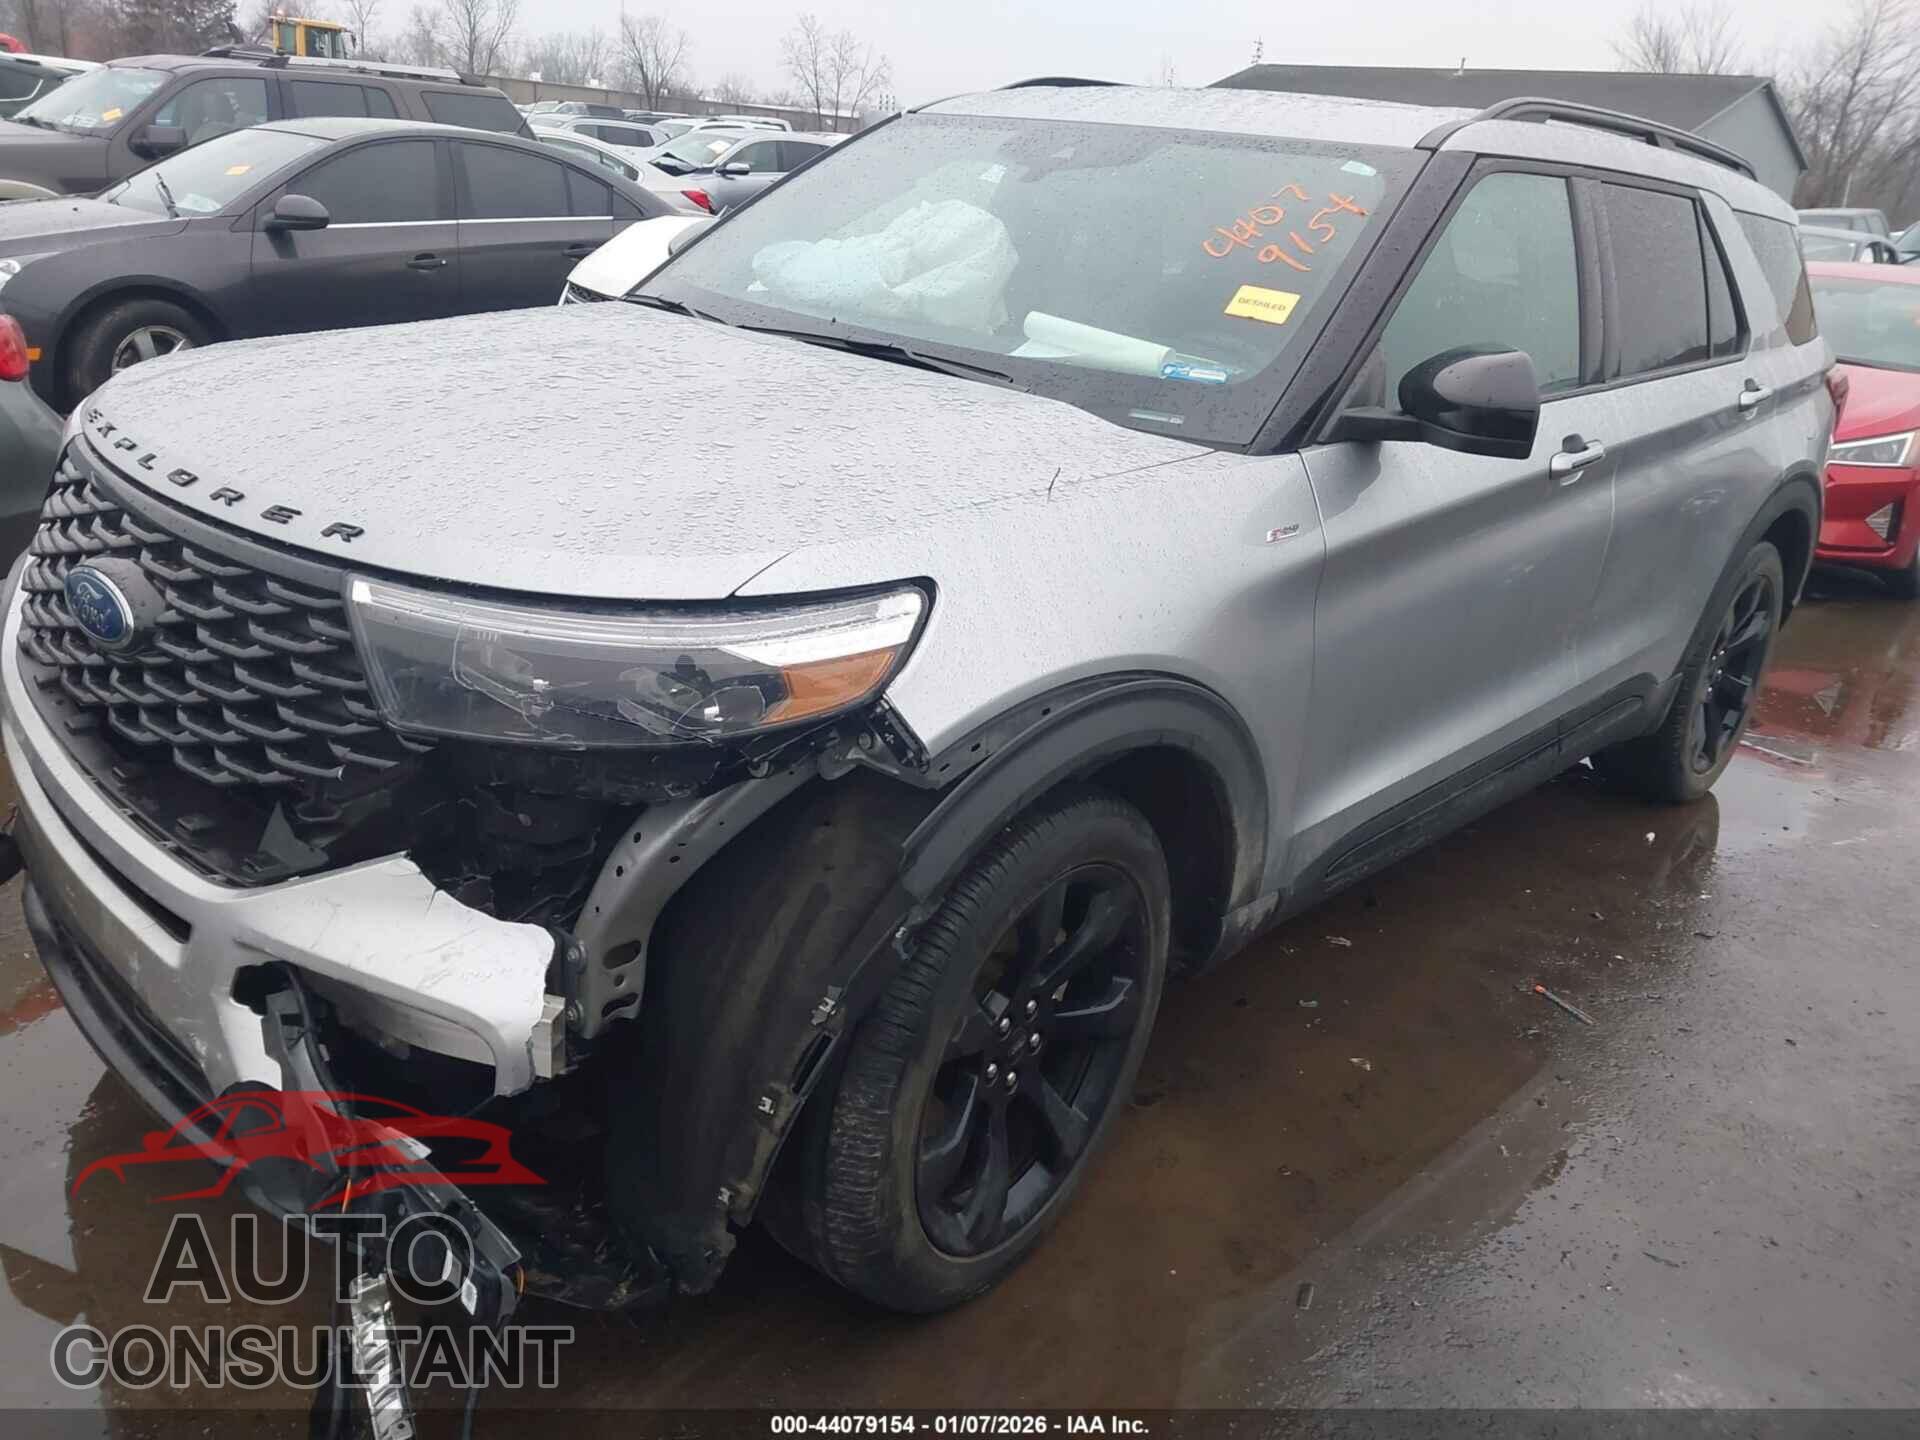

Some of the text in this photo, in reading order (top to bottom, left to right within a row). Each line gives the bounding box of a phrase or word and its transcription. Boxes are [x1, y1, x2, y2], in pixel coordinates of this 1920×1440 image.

[1256, 192, 1369, 272] 9154
[87, 408, 366, 543] EXPLORER
[73, 582, 112, 633] Ford
